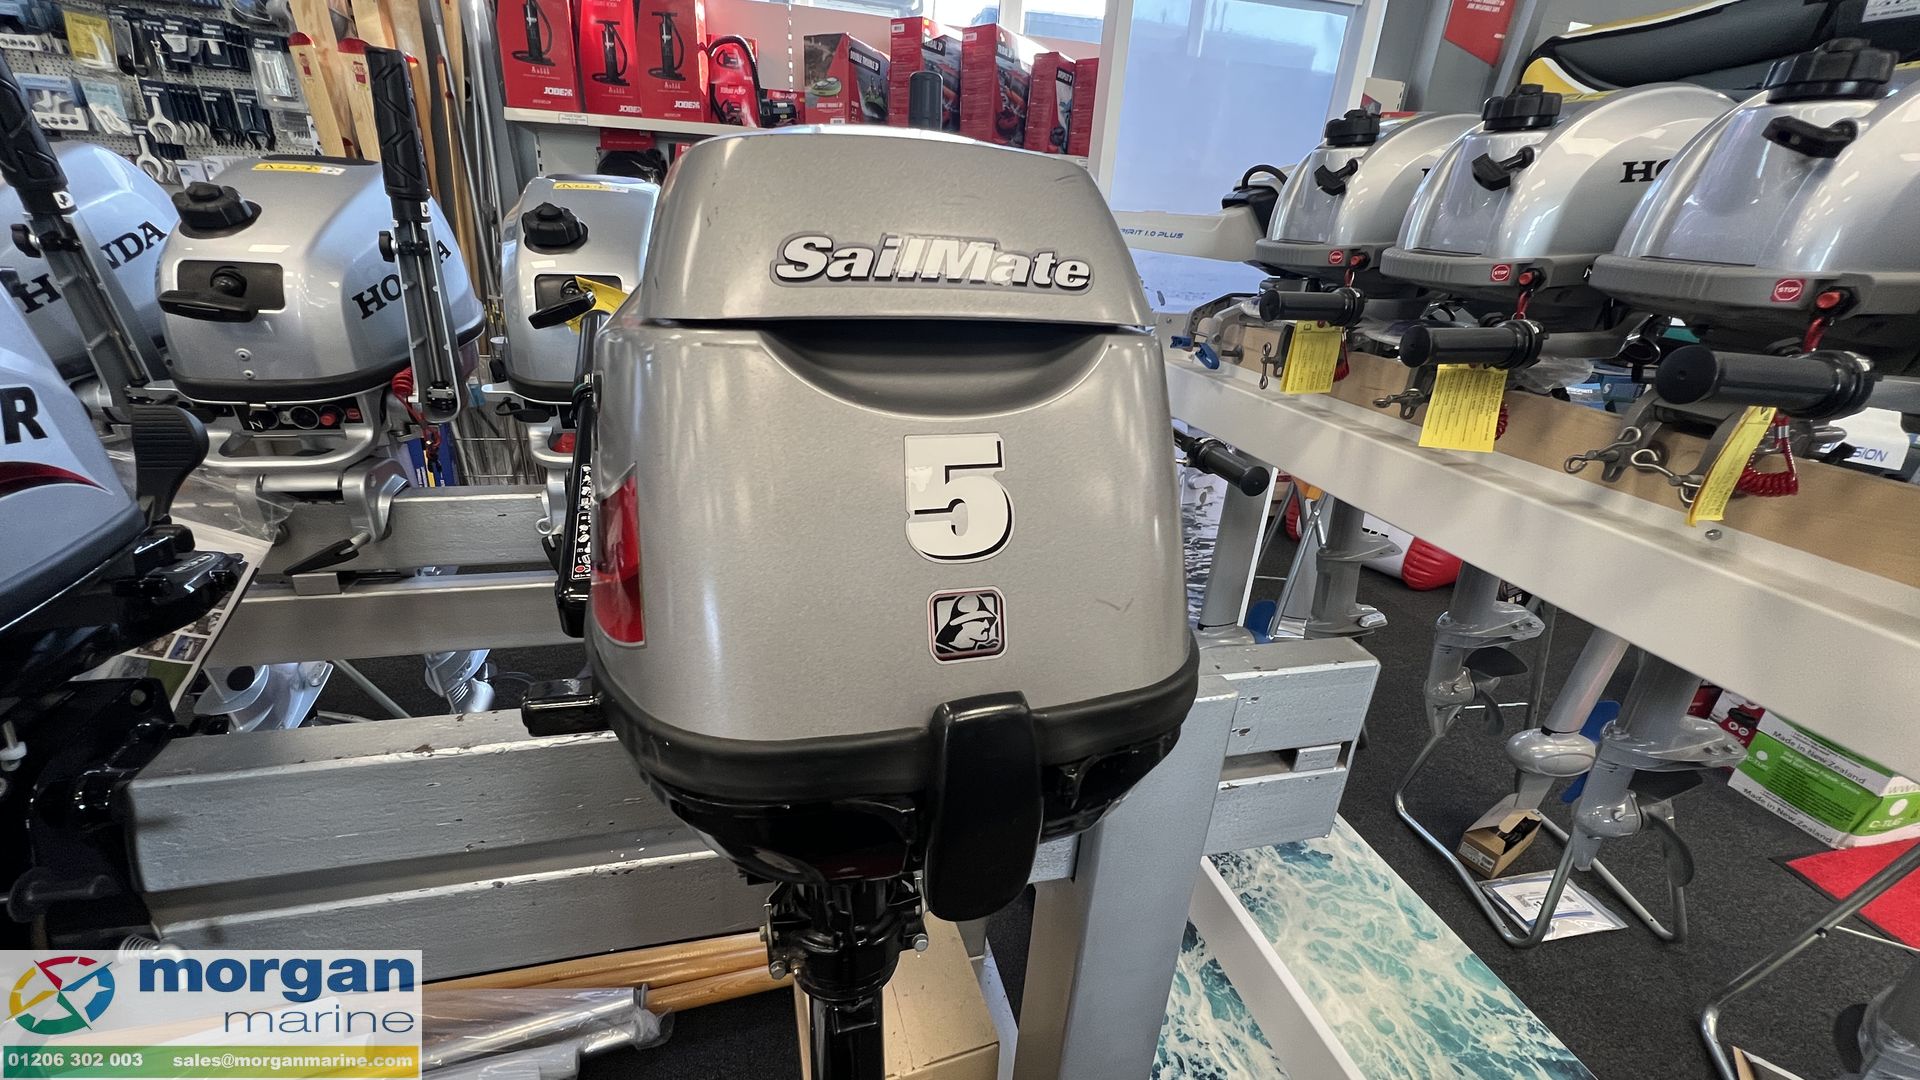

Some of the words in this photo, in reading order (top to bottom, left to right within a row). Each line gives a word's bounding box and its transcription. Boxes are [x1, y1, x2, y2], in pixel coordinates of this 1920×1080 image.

[1119, 228, 1141, 236] PIRIT
[1157, 231, 1184, 239] PLUS
[775, 234, 1092, 291] SailMate
[904, 434, 1013, 562] 5
[1773, 730, 1797, 749] Made
[1797, 744, 1806, 755] in
[1807, 750, 1829, 768] New
[1828, 760, 1867, 785] Zealand
[1743, 788, 1766, 806] Made
[1767, 801, 1776, 811] in
[1776, 804, 1797, 823] New
[1798, 817, 1833, 843] Zealand
